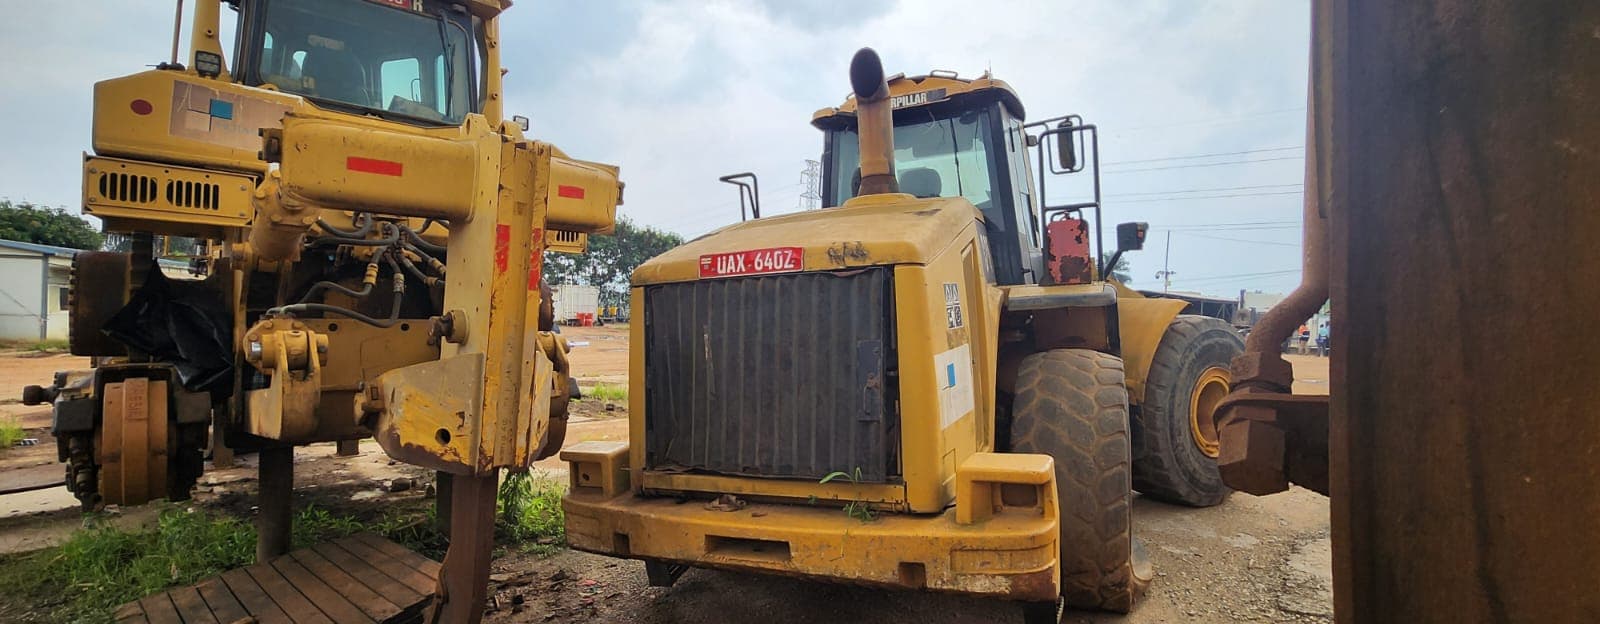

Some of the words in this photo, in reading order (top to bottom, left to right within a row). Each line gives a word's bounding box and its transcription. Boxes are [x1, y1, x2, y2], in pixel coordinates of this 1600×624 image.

[890, 92, 927, 108] RPILLAR
[716, 254, 746, 274] UAX
[754, 250, 795, 271] 640Z
